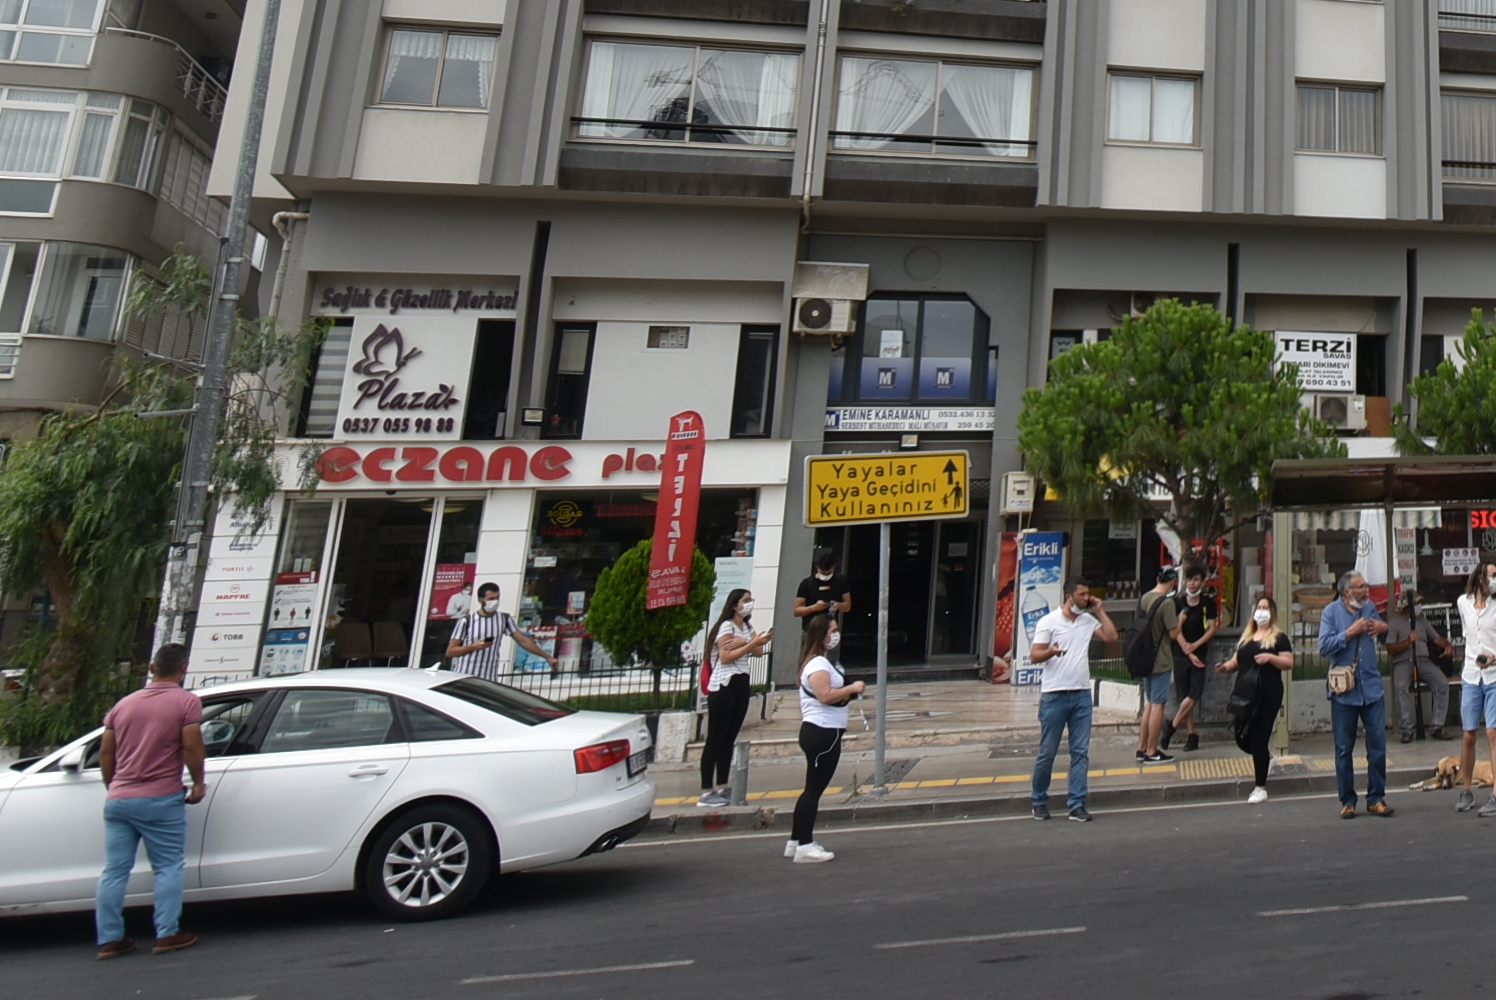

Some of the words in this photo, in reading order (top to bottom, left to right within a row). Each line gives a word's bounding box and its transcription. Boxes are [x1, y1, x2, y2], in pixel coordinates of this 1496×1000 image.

[321, 287, 372, 312] Sağlık
[389, 289, 453, 314] Güzellik
[453, 290, 518, 312] Merkezi
[1280, 337, 1352, 353] TERZİ
[1313, 361, 1350, 369] DİKİMEVİ
[879, 371, 892, 384] M
[937, 371, 950, 384] M
[352, 378, 450, 411] Plaza
[875, 409, 931, 420] KARAMANLI
[342, 417, 380, 432] 0537
[383, 417, 410, 432] 055
[414, 417, 432, 432] 98
[436, 417, 454, 432] 88
[841, 421, 867, 430] SERBEST
[315, 445, 573, 483] eczane
[832, 461, 918, 482] Yayalar
[816, 484, 860, 502] Yaya
[866, 479, 937, 497] Geçidini
[820, 500, 933, 518] Kullanınız
[1023, 542, 1058, 556] Erikli
